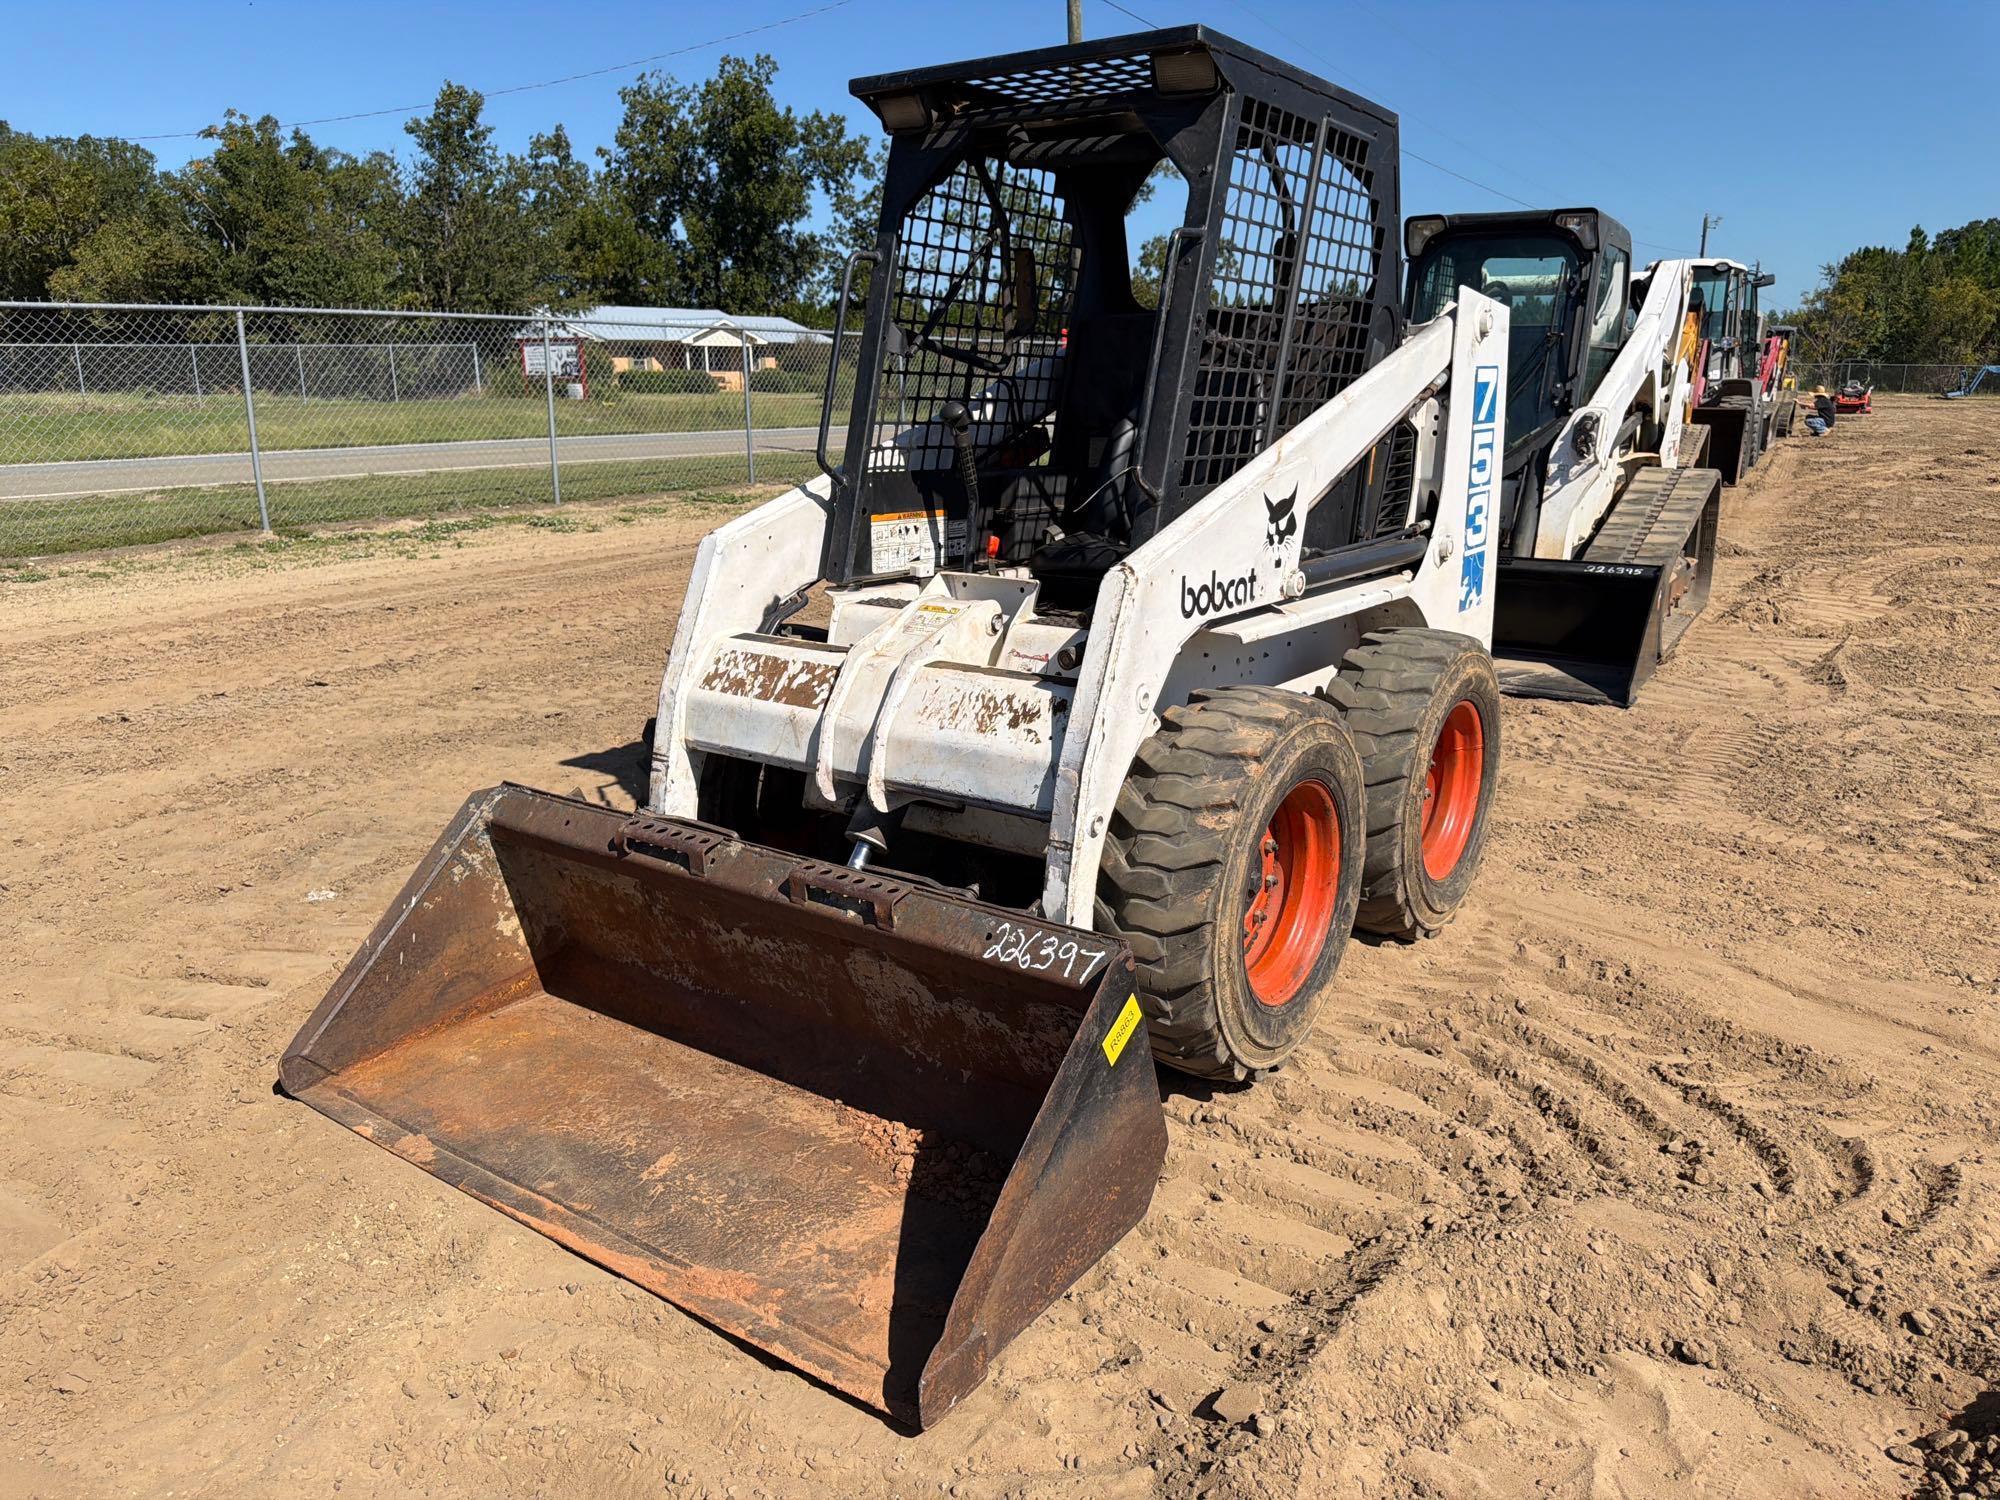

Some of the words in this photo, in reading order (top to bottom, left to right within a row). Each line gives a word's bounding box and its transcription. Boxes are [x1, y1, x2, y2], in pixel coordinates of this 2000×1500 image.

[1465, 365, 1499, 549] 753
[1180, 567, 1258, 620] bobcat
[1583, 565, 1644, 576] 226395
[982, 922, 1106, 985] 226397
[1110, 1010, 1135, 1052] R8863
